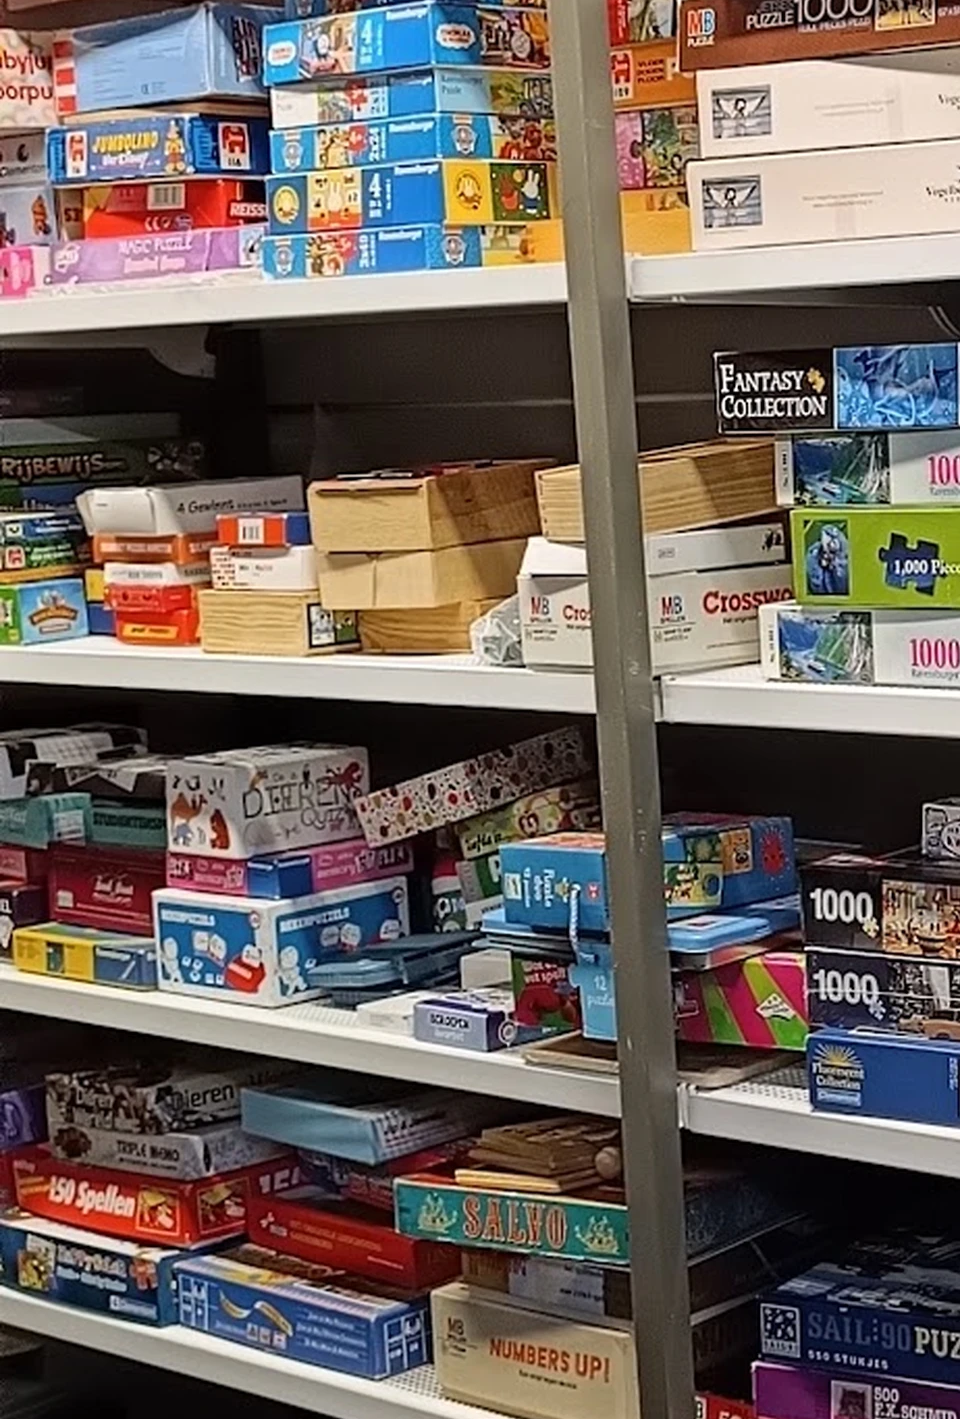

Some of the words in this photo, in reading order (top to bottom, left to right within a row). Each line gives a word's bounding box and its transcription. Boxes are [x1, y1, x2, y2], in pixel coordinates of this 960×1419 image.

[687, 8, 716, 38] MB
[746, 10, 795, 31] PUZZLE
[720, 363, 806, 395] FANTASY
[720, 393, 828, 420] COLLECTION
[530, 596, 551, 616] MB
[661, 595, 683, 616] MB
[908, 638, 960, 671] 1000
[810, 888, 874, 924] 1000
[812, 968, 879, 1005] 1000
[75, 1180, 136, 1218] Spellen
[462, 1194, 568, 1250] SALVO
[489, 1337, 572, 1373] NUMBERS
[574, 1352, 611, 1384] UP!
[873, 1385, 901, 1404] 500
